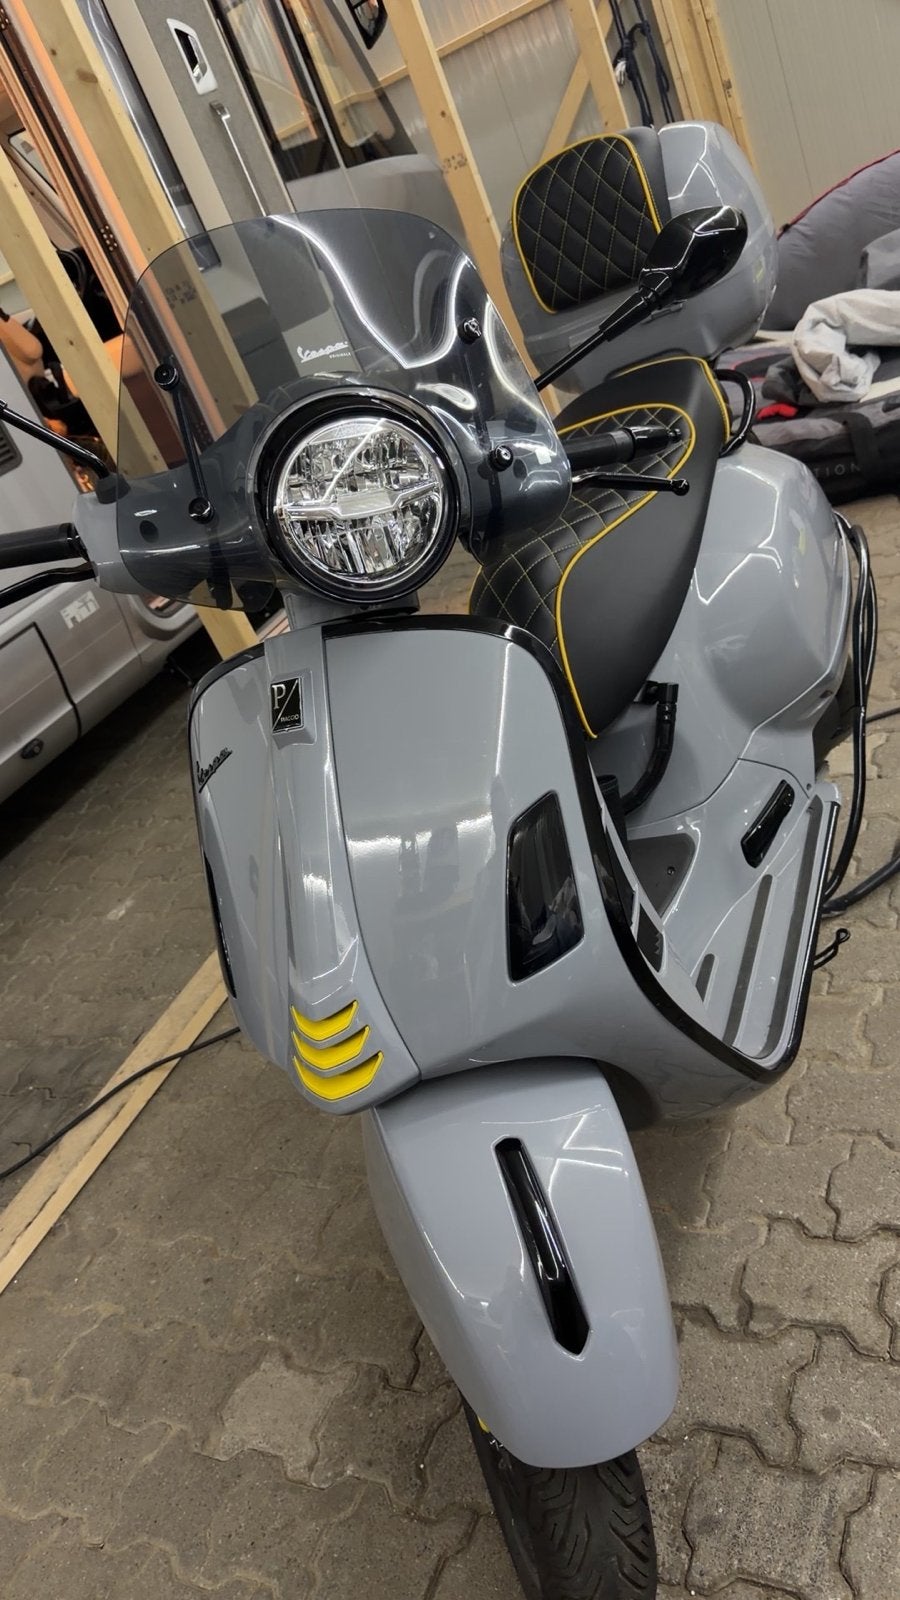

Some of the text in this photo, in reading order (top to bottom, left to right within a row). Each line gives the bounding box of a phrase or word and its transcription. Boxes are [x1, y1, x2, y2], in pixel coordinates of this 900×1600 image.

[297, 341, 349, 363] Vespa
[271, 683, 287, 710] P
[196, 747, 233, 794] Vespa
